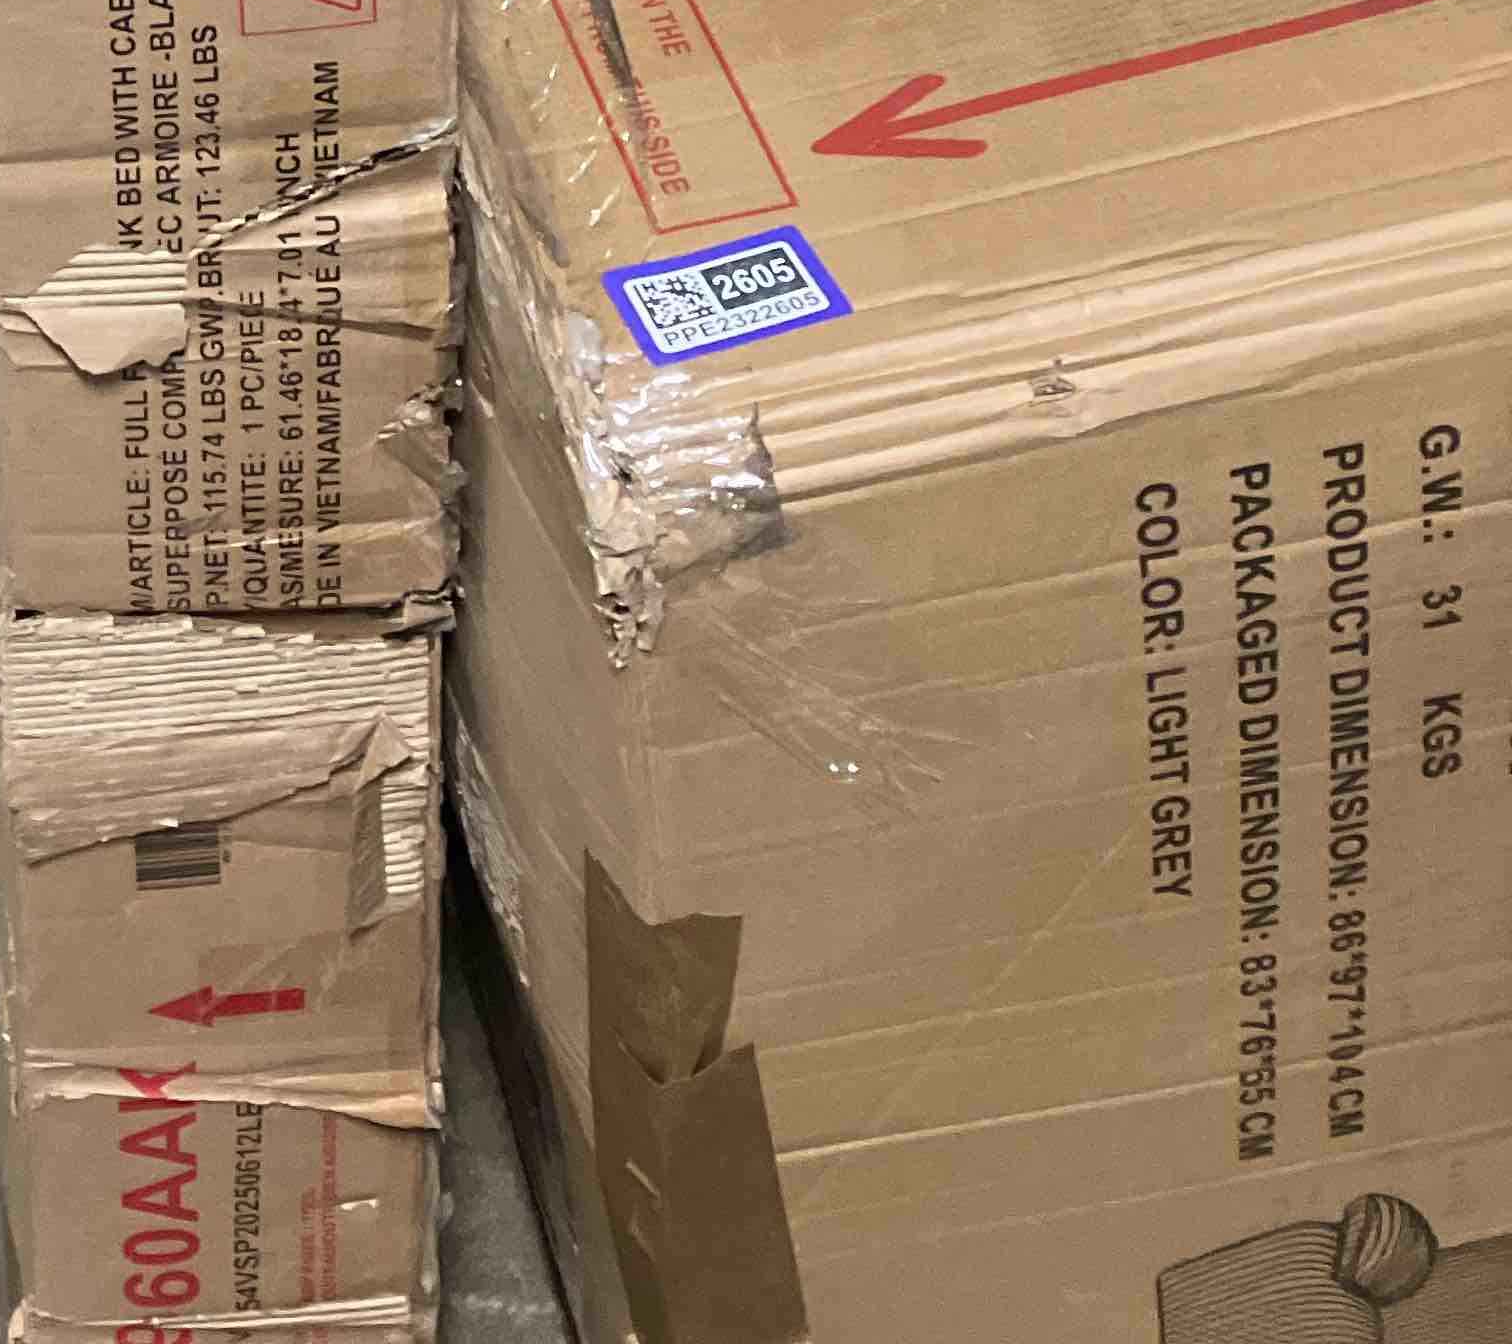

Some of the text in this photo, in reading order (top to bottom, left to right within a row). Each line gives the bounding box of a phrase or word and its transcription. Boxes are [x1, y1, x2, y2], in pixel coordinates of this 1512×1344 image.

[191, 23, 219, 84] LBS
[648, 8, 693, 58] THE
[110, 65, 140, 139] WITH
[192, 92, 222, 178] 123.46
[149, 71, 183, 205] ARMOIRE
[640, 134, 691, 195] SIDE
[113, 145, 142, 206] BED
[314, 214, 340, 257] AU
[710, 255, 797, 304] 2605
[662, 290, 821, 347] PPE2322605
[121, 390, 150, 459] FULL
[198, 367, 227, 423] LBS
[199, 433, 229, 512] 115.74
[316, 543, 342, 566] IN
[1228, 457, 1278, 707] PACKAGED
[1321, 438, 1370, 660] PRODUCT
[1419, 420, 1464, 781] G.W.: 31 KGS
[1134, 475, 1195, 899] COLOR: LIGHT GREY
[1324, 666, 1371, 901] DIMENSION:
[1233, 711, 1282, 945] DIMENSION:
[1236, 1111, 1277, 1162] CM
